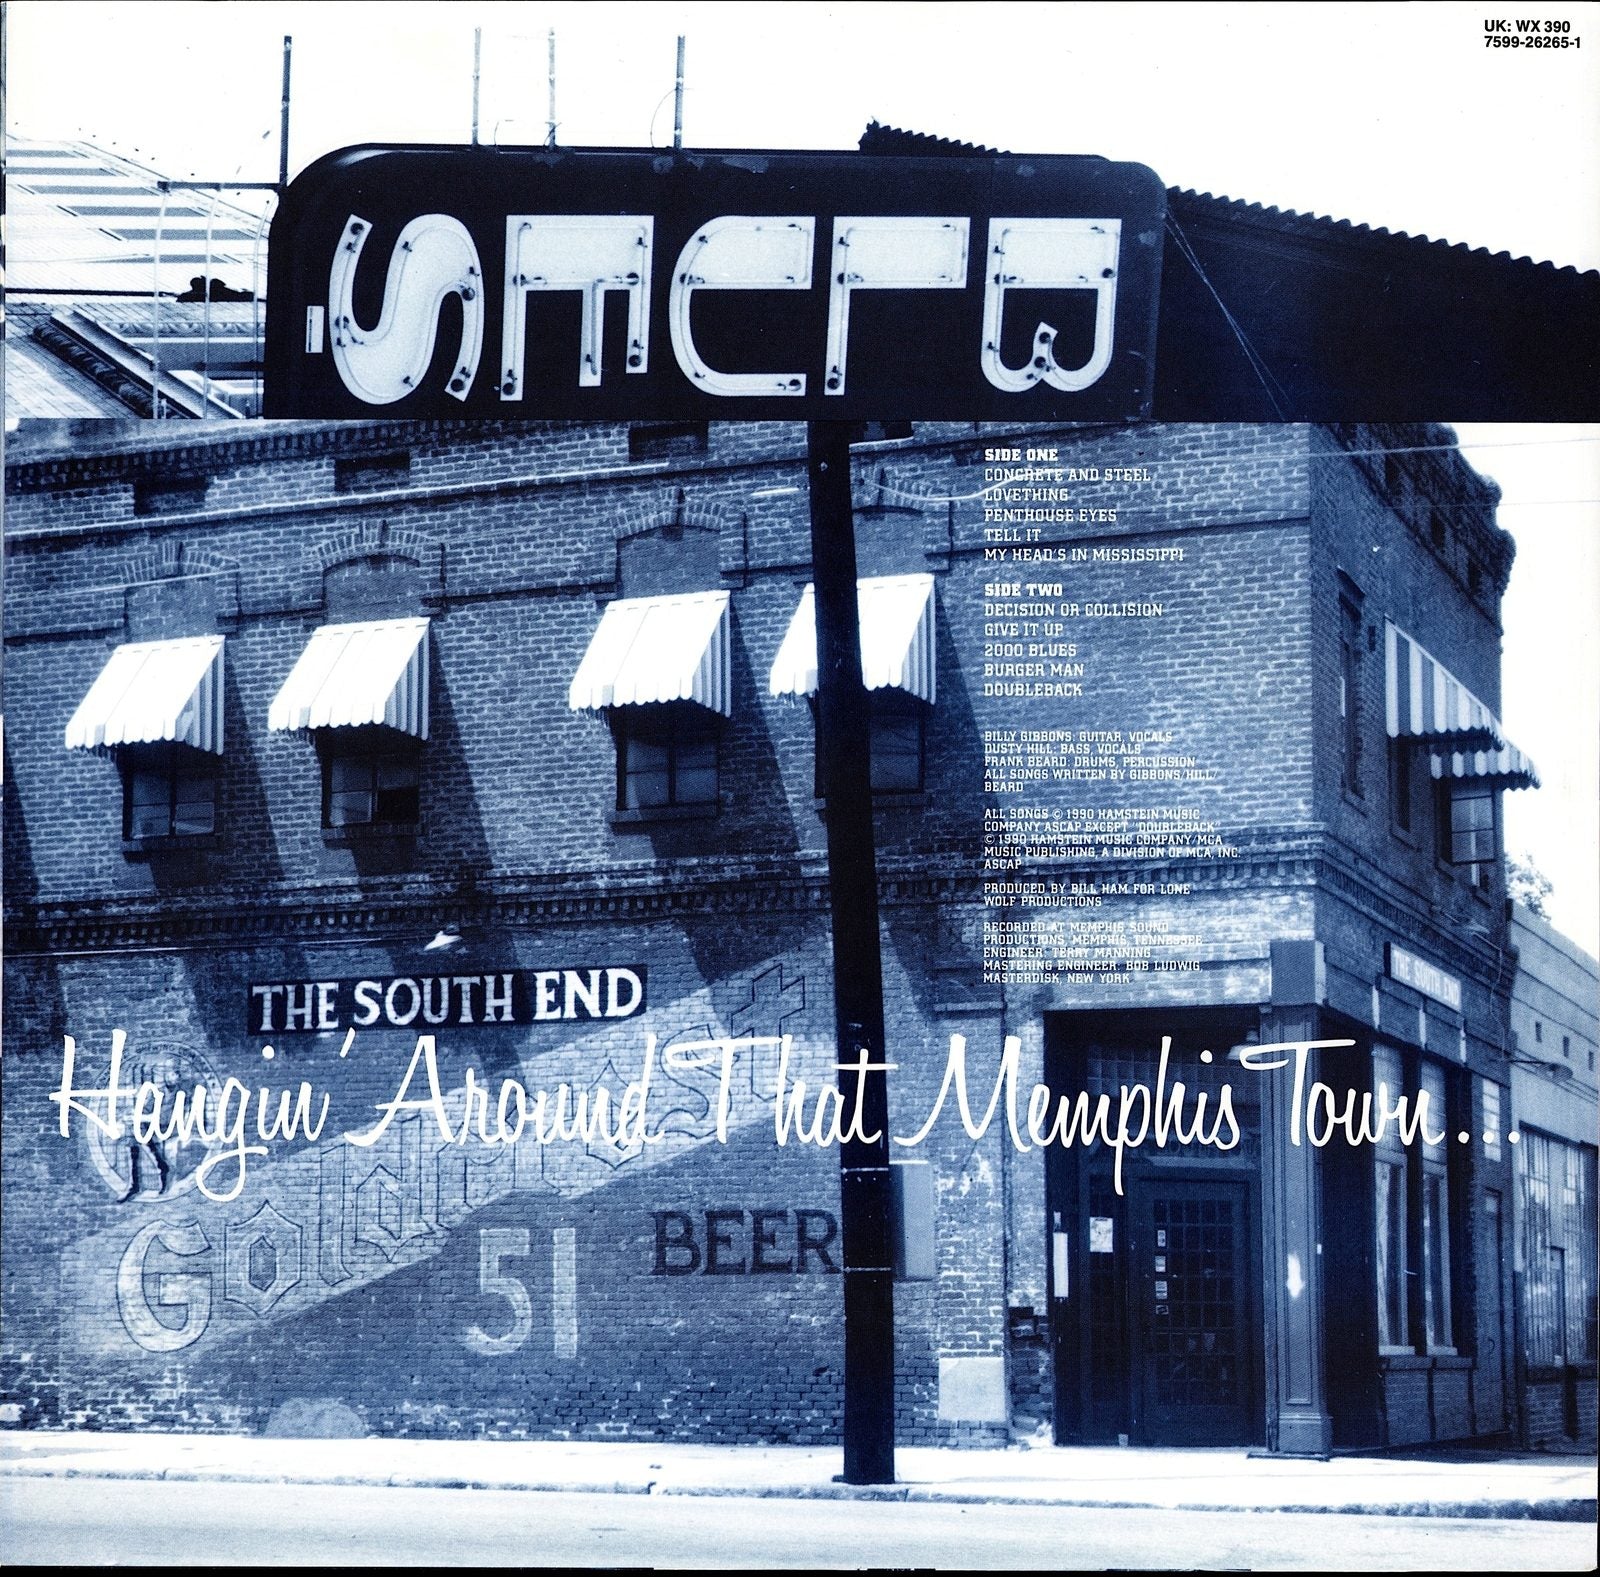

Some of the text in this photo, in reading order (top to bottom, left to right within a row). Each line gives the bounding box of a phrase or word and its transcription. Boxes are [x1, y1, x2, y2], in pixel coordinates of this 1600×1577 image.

[328, 213, 1122, 405] BLUES
[252, 967, 644, 1031] THE SOUTH END
[649, 1208, 843, 1276] BEER
[465, 1227, 578, 1359] 51
